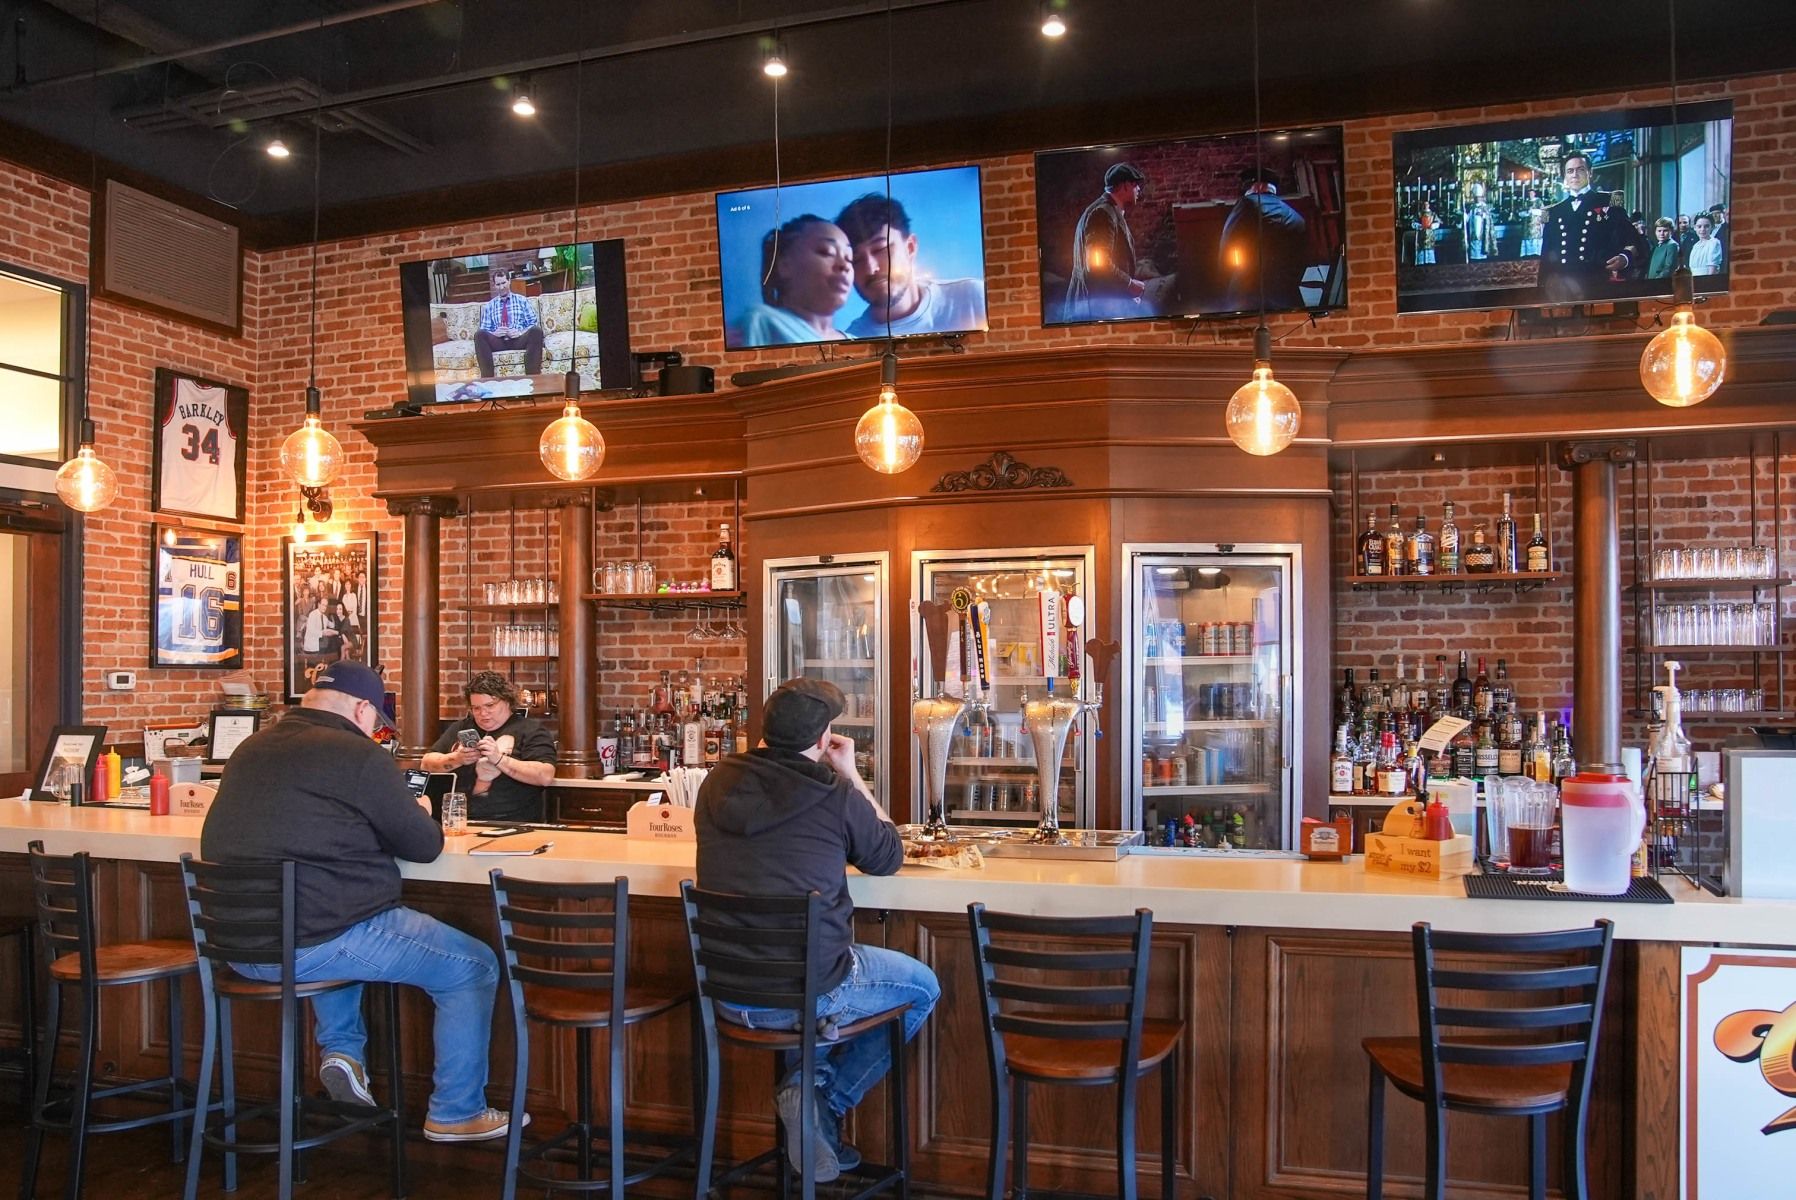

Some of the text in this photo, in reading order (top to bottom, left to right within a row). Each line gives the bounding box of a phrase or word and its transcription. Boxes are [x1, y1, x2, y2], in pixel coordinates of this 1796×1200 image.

[178, 403, 225, 427] BARKLEY
[181, 423, 220, 466] 34
[189, 563, 215, 580] HULL
[178, 583, 225, 641] 16
[1047, 596, 1056, 631] ULTRA
[649, 822, 683, 833] Four Roses
[1400, 843, 1431, 858] I want
[1400, 861, 1431, 873] my $2
